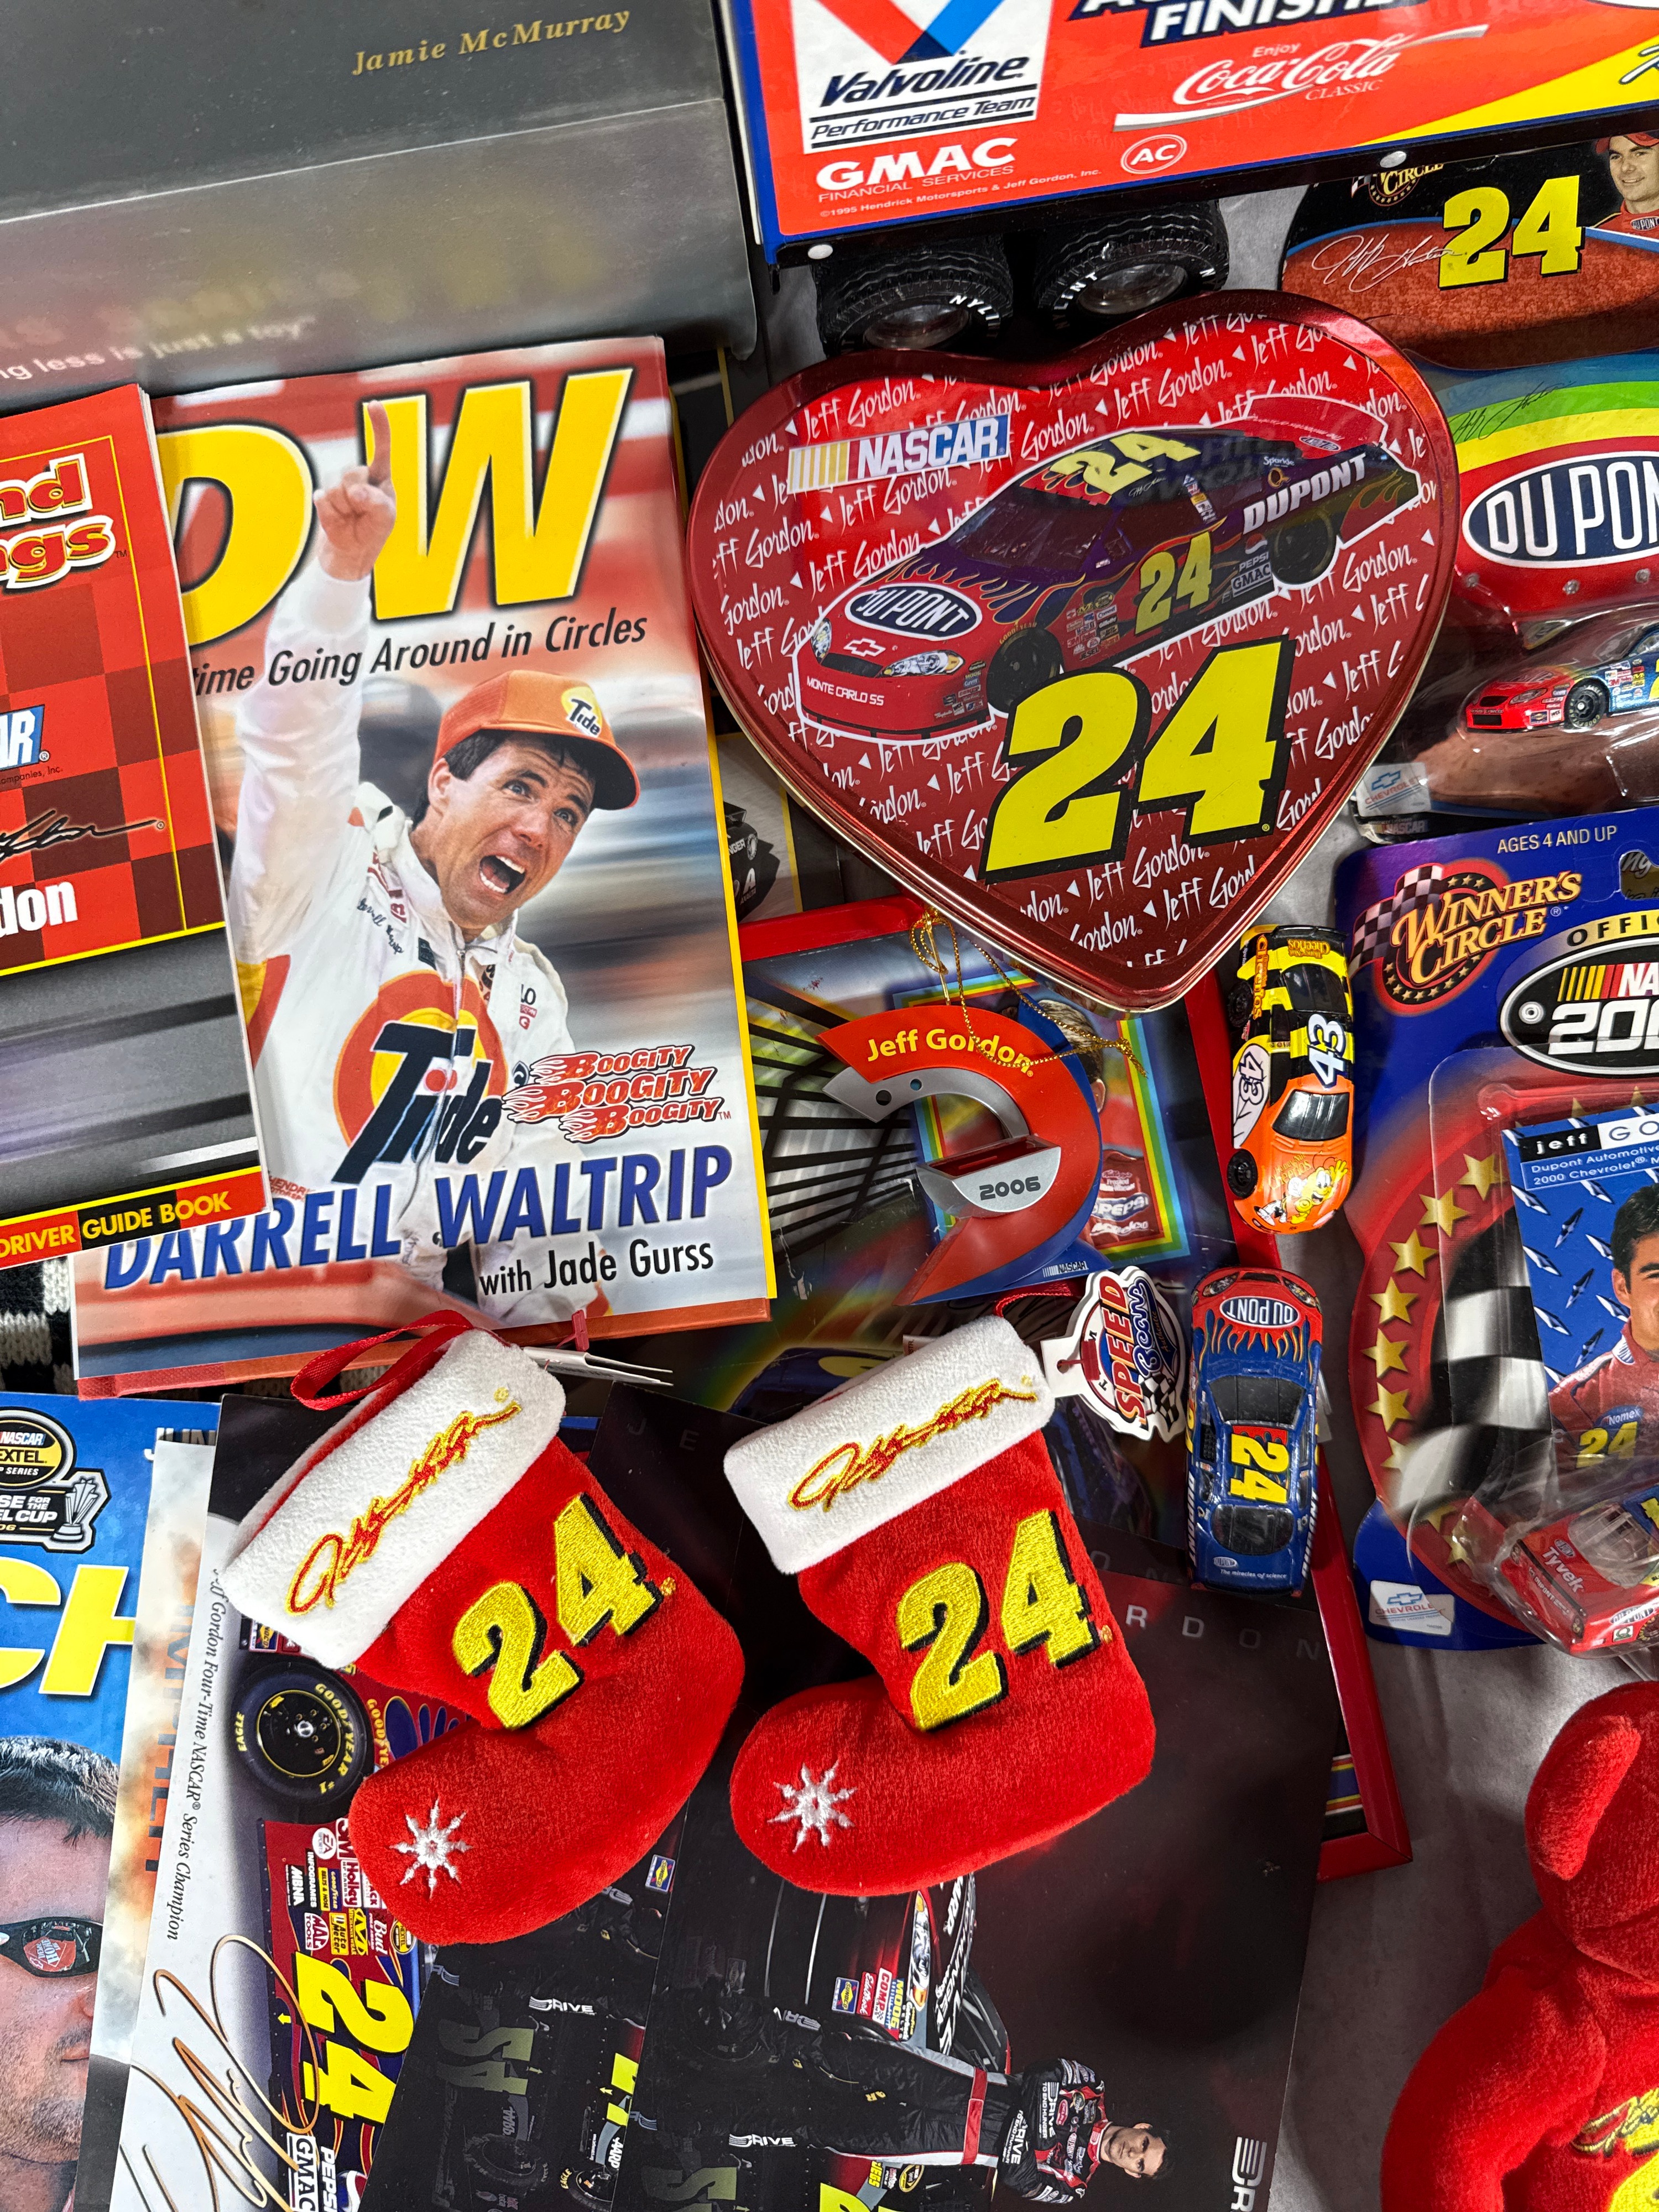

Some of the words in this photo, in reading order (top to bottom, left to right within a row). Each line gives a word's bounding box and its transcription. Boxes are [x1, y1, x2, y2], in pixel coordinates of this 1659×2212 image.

[352, 41, 446, 75] Jamie
[458, 11, 630, 55] McMurray
[1253, 42, 1301, 60] Enjoy
[820, 49, 1024, 107] Valvoline
[1172, 32, 1414, 106] Coca-Cola
[1305, 80, 1384, 101] CLASSIC
[811, 108, 967, 140] Performance
[973, 95, 1035, 118] Team
[816, 137, 1018, 190] GMAC
[1131, 144, 1176, 165] AC
[818, 182, 912, 204] FINANCIAL
[922, 165, 1014, 187] SERVICES
[820, 205, 858, 218] ©1995
[860, 197, 913, 213] Hendrick
[916, 186, 989, 205] Motorsports
[992, 183, 1000, 191] &
[1003, 178, 1027, 190] Jeff
[1029, 172, 1077, 187] Gordon,
[1080, 168, 1103, 178] Inc.
[1439, 175, 1584, 287] 24
[33, 353, 105, 372] less
[108, 345, 144, 361] is
[148, 333, 216, 358] just
[1252, 324, 1291, 373] Jeff
[804, 398, 841, 445] Jeff
[848, 379, 918, 427] Gordon
[1116, 378, 1153, 424] Jeff
[1159, 356, 1228, 408] Gordon
[858, 418, 999, 480] NASCAR
[1021, 408, 1090, 462] Gordon
[1048, 434, 1201, 495] 24
[838, 484, 877, 538] Jeff
[1243, 452, 1366, 535] DUPONT
[745, 515, 815, 569] Gordon
[1239, 551, 1270, 572] PEPSI
[1343, 541, 1413, 593] Gordon
[808, 550, 847, 602] Jeff
[1140, 531, 1212, 636] 24
[1233, 565, 1271, 591] GMAC
[1372, 581, 1410, 635] Jeff
[268, 649, 362, 686] Going
[369, 622, 496, 674] Around
[501, 624, 533, 659] in
[545, 607, 648, 653] Circles
[806, 677, 834, 695] MONTE
[835, 683, 869, 703] CARLO
[869, 691, 885, 707] SS
[1344, 649, 1381, 701] Jeff
[570, 697, 601, 738] Tide
[47, 765, 64, 775] Inc.
[946, 750, 987, 803] Jeff
[985, 641, 1277, 873] 24
[1497, 834, 1540, 855] AGES
[1543, 832, 1552, 848] 4
[1555, 828, 1590, 847] AND
[1594, 825, 1617, 842] UP
[1086, 861, 1125, 912] Jeff
[1132, 834, 1204, 889] Gordon
[1164, 876, 1203, 931] Jeff
[1391, 870, 1584, 962] WINNER'S
[1409, 907, 1548, 984] CIRCLE
[573, 1045, 693, 1079] BOOGITY
[868, 1029, 919, 1062] Jeff
[925, 1028, 1033, 1077] Gordon
[1307, 1013, 1348, 1089] 43
[331, 1018, 503, 1185] Tide
[552, 1067, 716, 1115] BOOGITY
[1238, 1050, 1265, 1106] 43
[602, 1097, 724, 1135] BOOGITY
[1531, 1156, 1583, 1175] Dupont
[1536, 1132, 1588, 1156] jeff
[979, 1176, 1041, 1201] 2006
[1533, 1172, 1565, 1186] 2000
[82, 1207, 153, 1239] GUIDE
[160, 1191, 231, 1224] BOOK
[105, 1183, 401, 1290] DARRELL
[435, 1145, 733, 1249] WALTRIP
[479, 1265, 531, 1296] with
[544, 1240, 617, 1290] Jade
[629, 1238, 714, 1279] Gurss
[1057, 1260, 1089, 1274] NASCAR
[1100, 1275, 1150, 1430] SPEED
[1, 1431, 44, 1446] NASCAR
[1608, 1408, 1641, 1426] Nomex
[1230, 1433, 1290, 1504] 24
[1575, 1421, 1640, 1469] 24
[6, 1467, 39, 1476] SERIES
[19, 1510, 58, 1524] CUP
[1534, 1577, 1554, 1601] DUPONT
[1542, 1546, 1584, 1593] Tyvek
[205, 1603, 227, 1660] Gordon
[452, 1493, 658, 1730] 24
[896, 1509, 1102, 1732] 24
[195, 1660, 219, 1740] Four-Time
[236, 1711, 248, 1752] EAGLE
[315, 1683, 355, 1777] GOODYEAR
[178, 1813, 198, 1859] Series
[166, 1861, 191, 1941] Champion
[291, 1865, 305, 1906] MBNA
[307, 1851, 317, 1908] INFOGRAMES
[345, 1861, 359, 1906] Holley
[373, 1919, 388, 1955] Bud
[529, 1996, 596, 2015] DRIVE
[841, 1981, 853, 2011] SUNOCO
[878, 1972, 890, 2012] COMP
[890, 1980, 904, 2028] MOOG
[295, 1952, 415, 2124] 24
[728, 2133, 795, 2147] DRIVE
[295, 2137, 316, 2212] GMAC
[320, 2146, 338, 2212] PEPSI
[868, 2161, 884, 2188] JEGS
